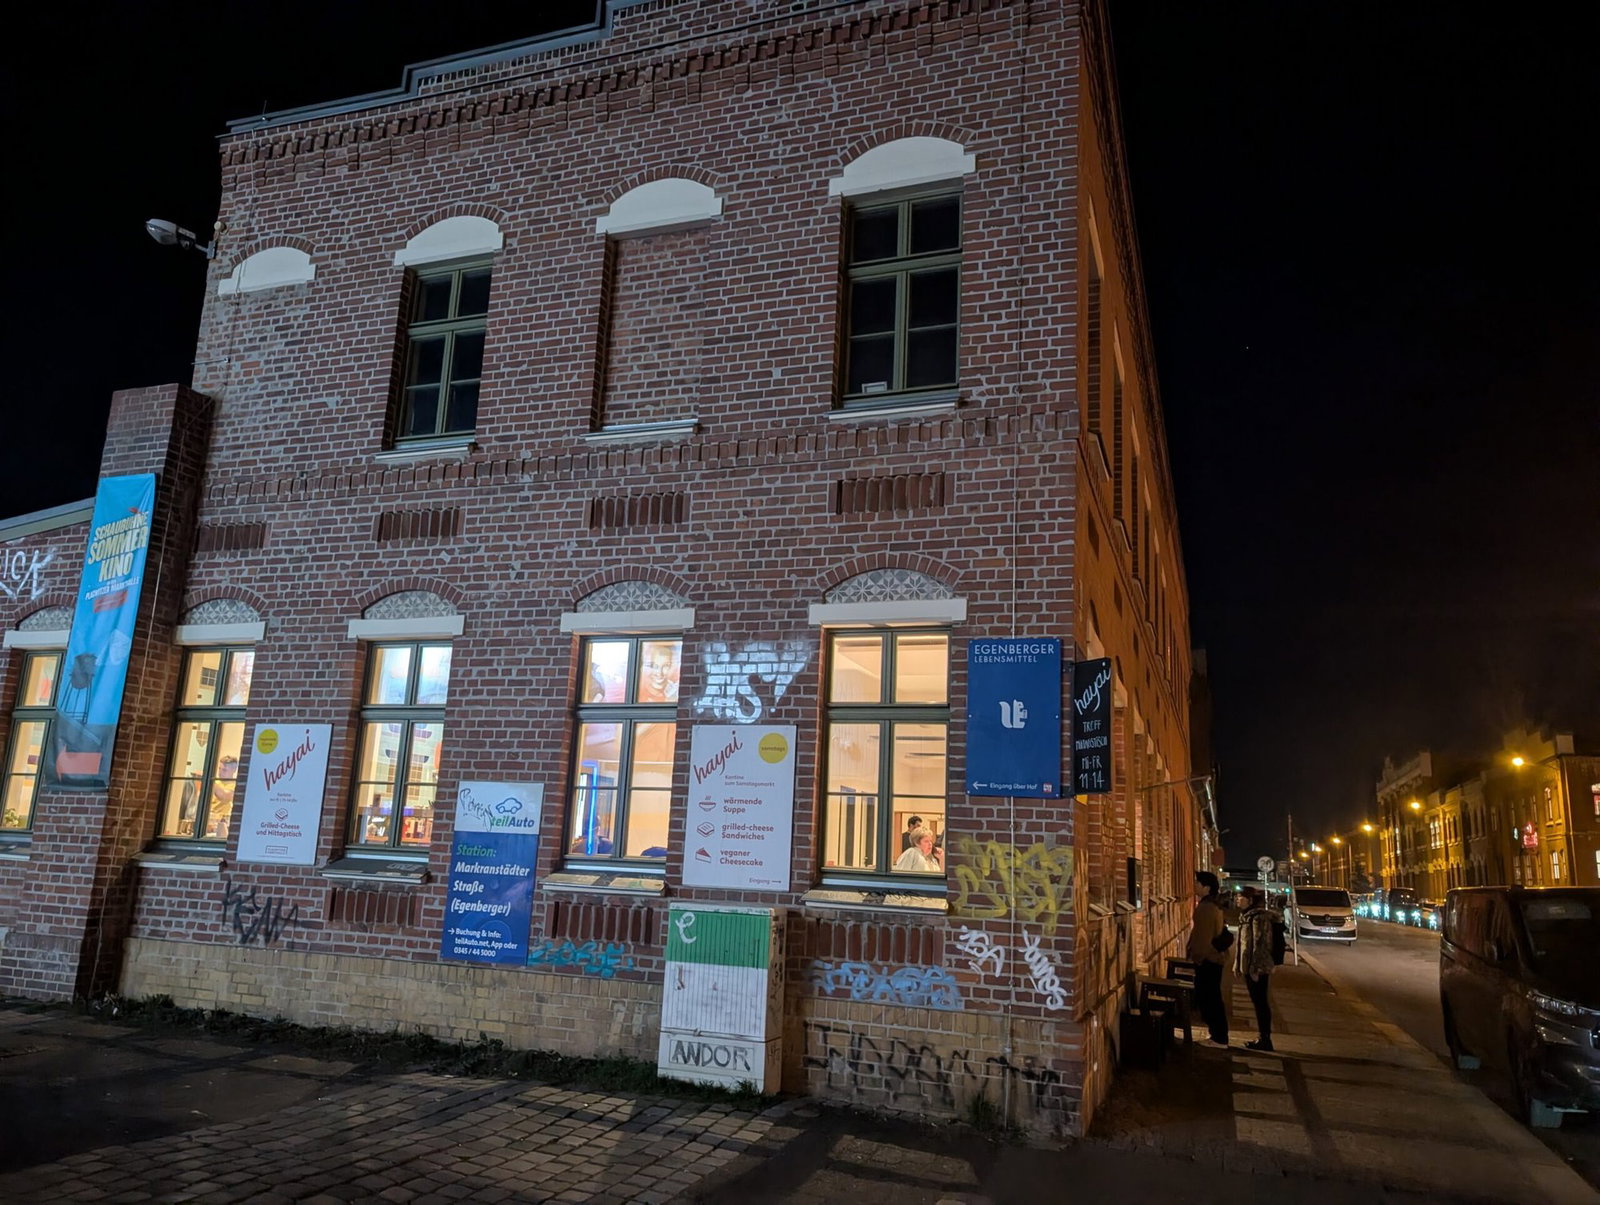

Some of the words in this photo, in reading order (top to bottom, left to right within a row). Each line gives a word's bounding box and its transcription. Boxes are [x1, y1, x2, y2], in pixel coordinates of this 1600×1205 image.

[88, 525, 148, 564] SOMMER
[98, 552, 134, 582] KINO
[974, 644, 1055, 655] EGENBERGER
[974, 655, 1038, 663] LEBENSMITTEL
[1074, 661, 1111, 716] hayai
[264, 729, 315, 791] hayai
[693, 730, 743, 785] hayai
[989, 782, 1012, 790] Eingang
[723, 797, 763, 805] wärmende
[723, 806, 746, 814] Suppe
[260, 822, 300, 830] Grilled-Cheese
[491, 816, 535, 829] teilAuto
[722, 823, 774, 832] grilled-cheese
[268, 830, 302, 838] Mittagstisch
[721, 832, 765, 840] Sandwiches
[456, 843, 497, 857] Station:
[720, 849, 751, 858] veganer
[719, 858, 763, 867] Cheesecake
[455, 862, 530, 877] Markranstädter
[453, 880, 485, 896] Straße
[451, 898, 511, 916] (Egenberger)
[455, 928, 480, 938] Buchung
[488, 930, 502, 938] Info:
[491, 941, 502, 949] App
[503, 942, 518, 950] oder
[672, 1040, 751, 1071] ANDOR
